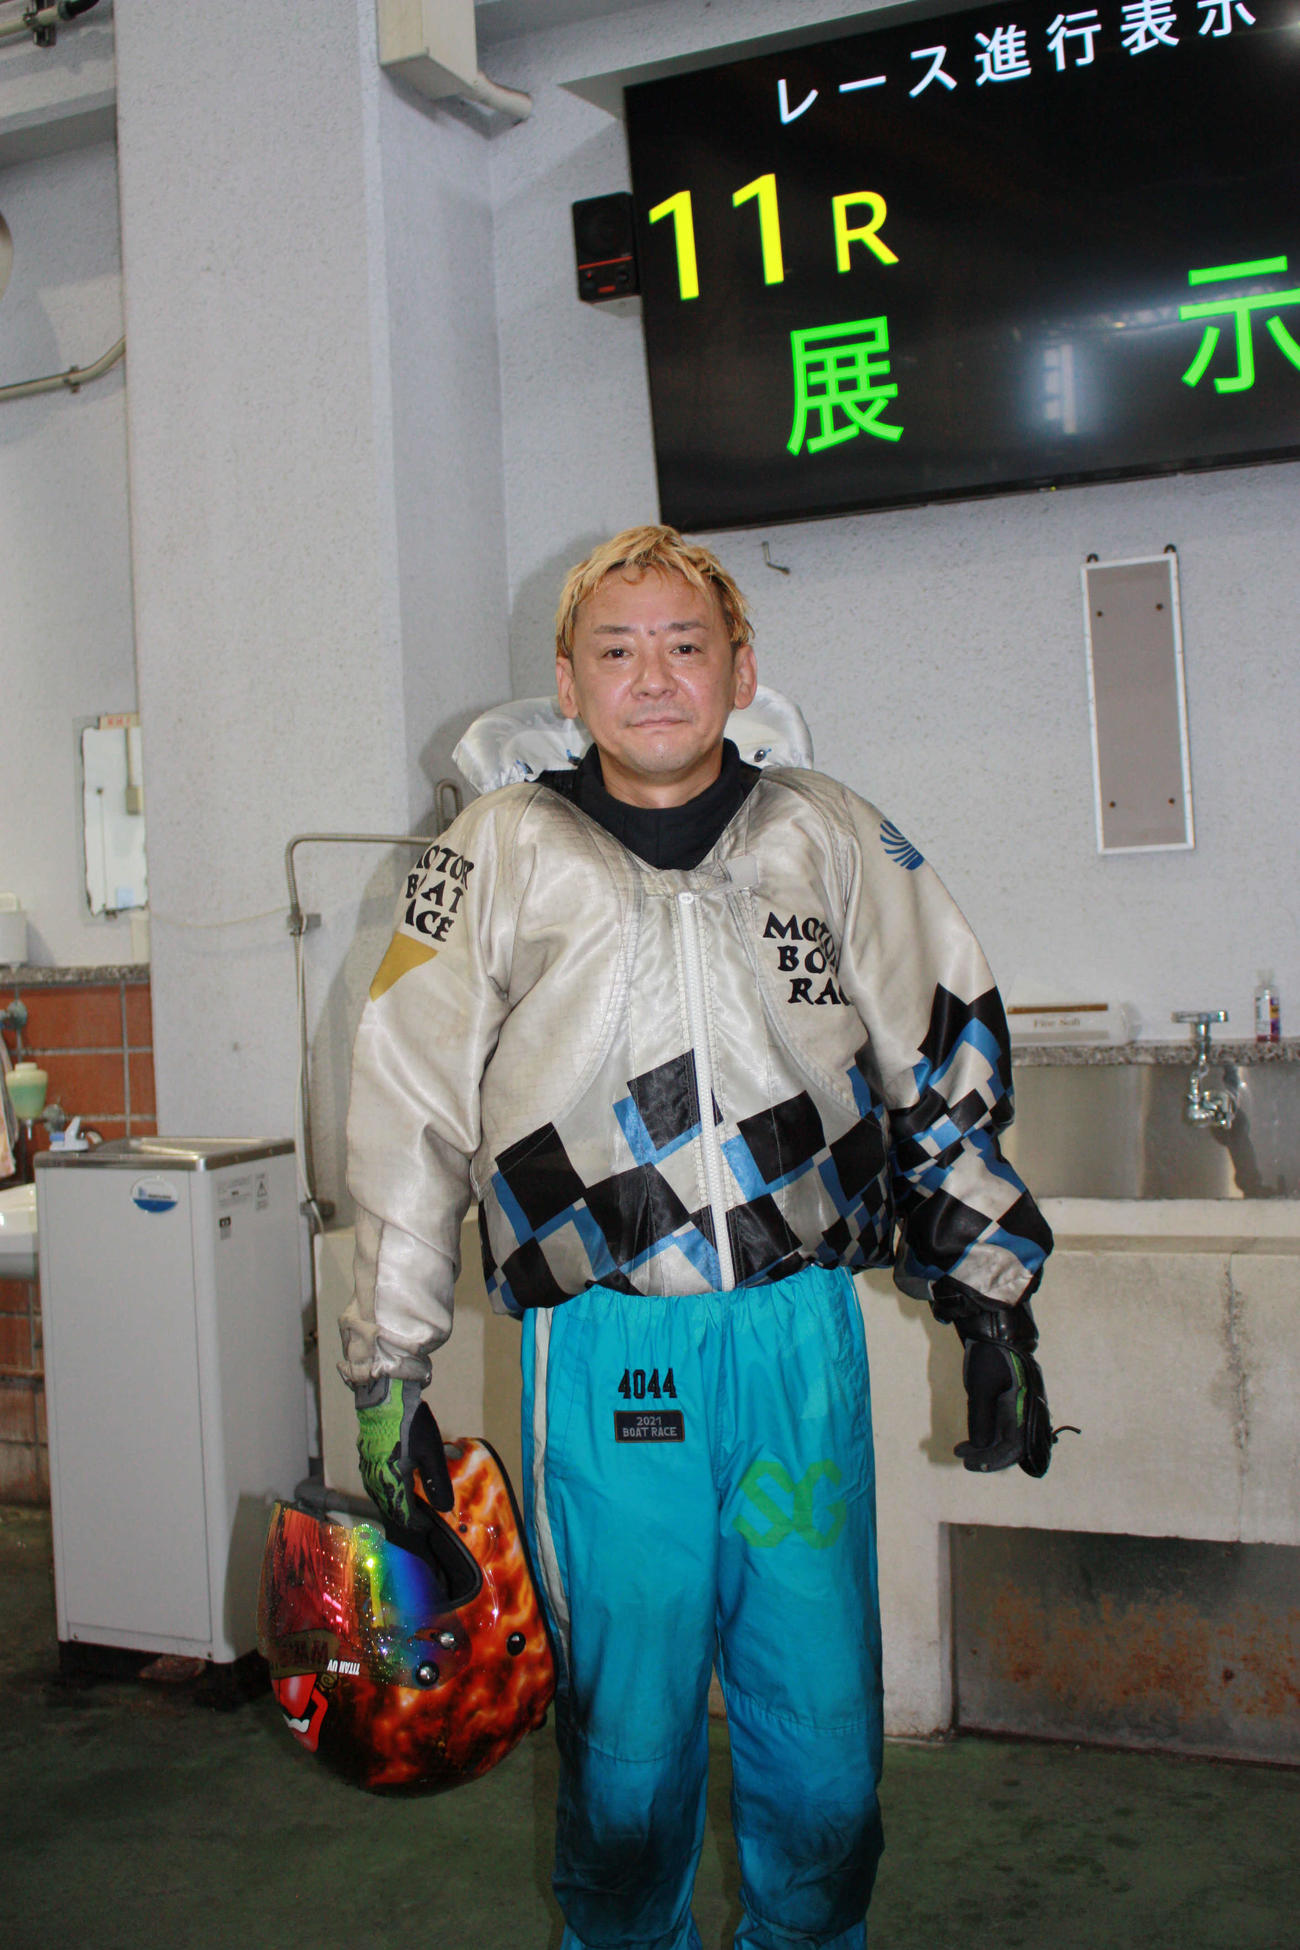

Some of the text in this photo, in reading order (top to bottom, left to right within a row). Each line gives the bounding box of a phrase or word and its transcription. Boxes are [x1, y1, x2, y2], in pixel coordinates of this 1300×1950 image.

[776, 0, 1257, 124] レース進行表示
[405, 873, 465, 914] BAT
[762, 911, 837, 968] MOTO
[777, 945, 827, 974] BO
[617, 1367, 677, 1399] 4044
[622, 1426, 678, 1438] BOAT RACE
[636, 1416, 662, 1426] 2021
[731, 1458, 847, 1550] SG
[327, 1659, 360, 1676] TITAN UV
